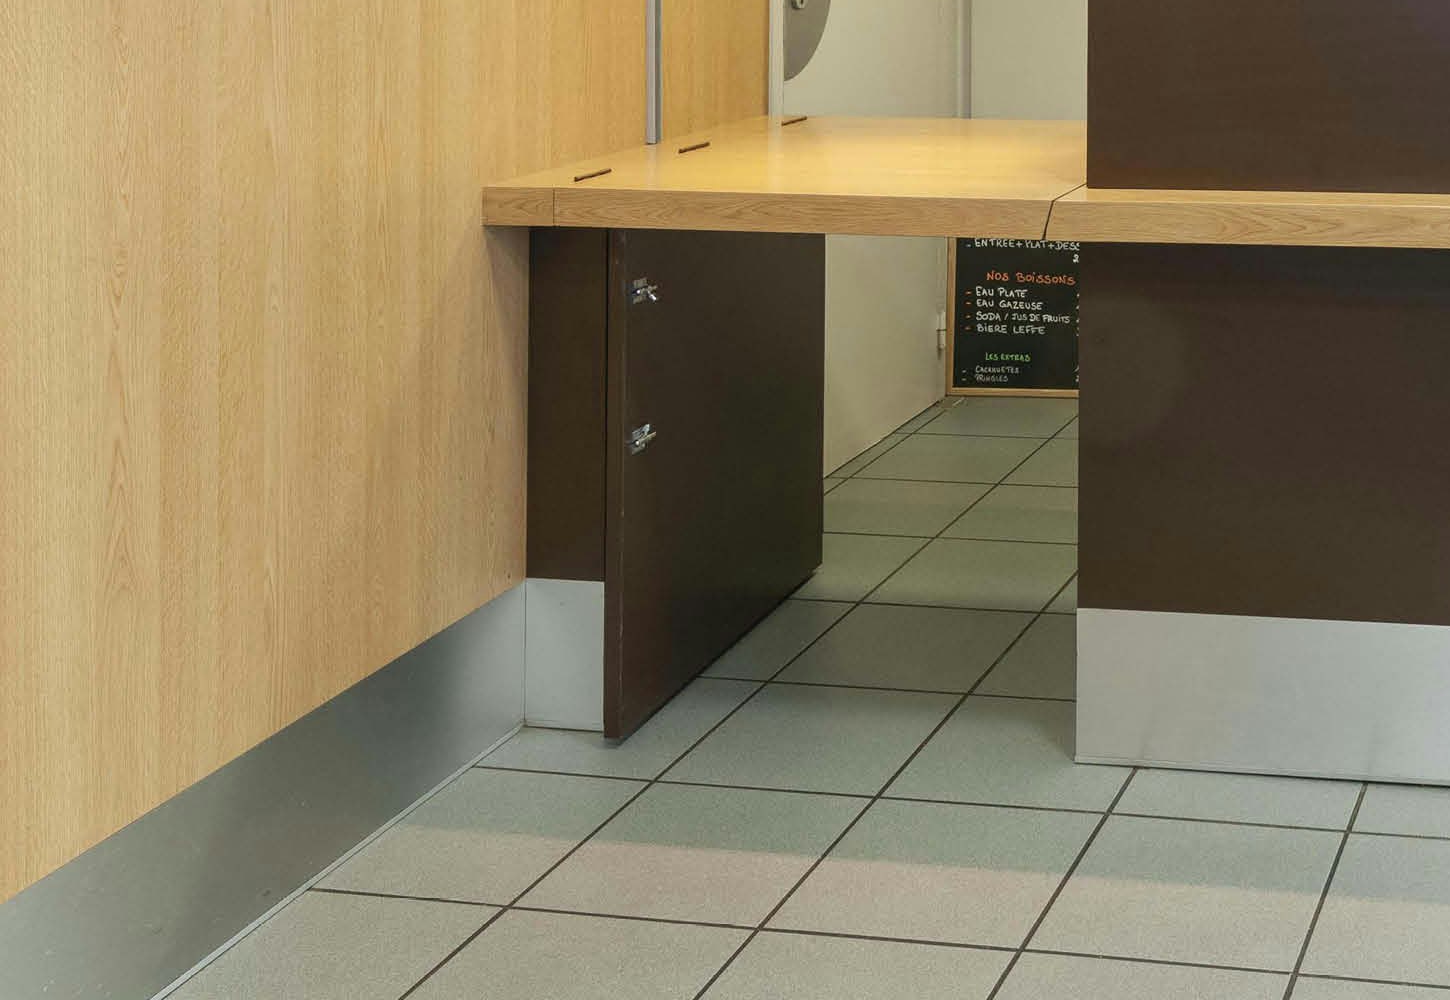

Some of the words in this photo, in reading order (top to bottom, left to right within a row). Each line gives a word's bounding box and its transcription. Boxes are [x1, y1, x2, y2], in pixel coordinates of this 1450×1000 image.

[986, 270, 1009, 282] NOS
[976, 286, 994, 297] EAU
[997, 287, 1028, 298] PLATE
[976, 299, 994, 308] EAU
[1000, 300, 1043, 311] GAZEUSE
[1011, 313, 1028, 321] JUS
[1029, 313, 1040, 322] DE
[1013, 325, 1046, 335] LEFFE
